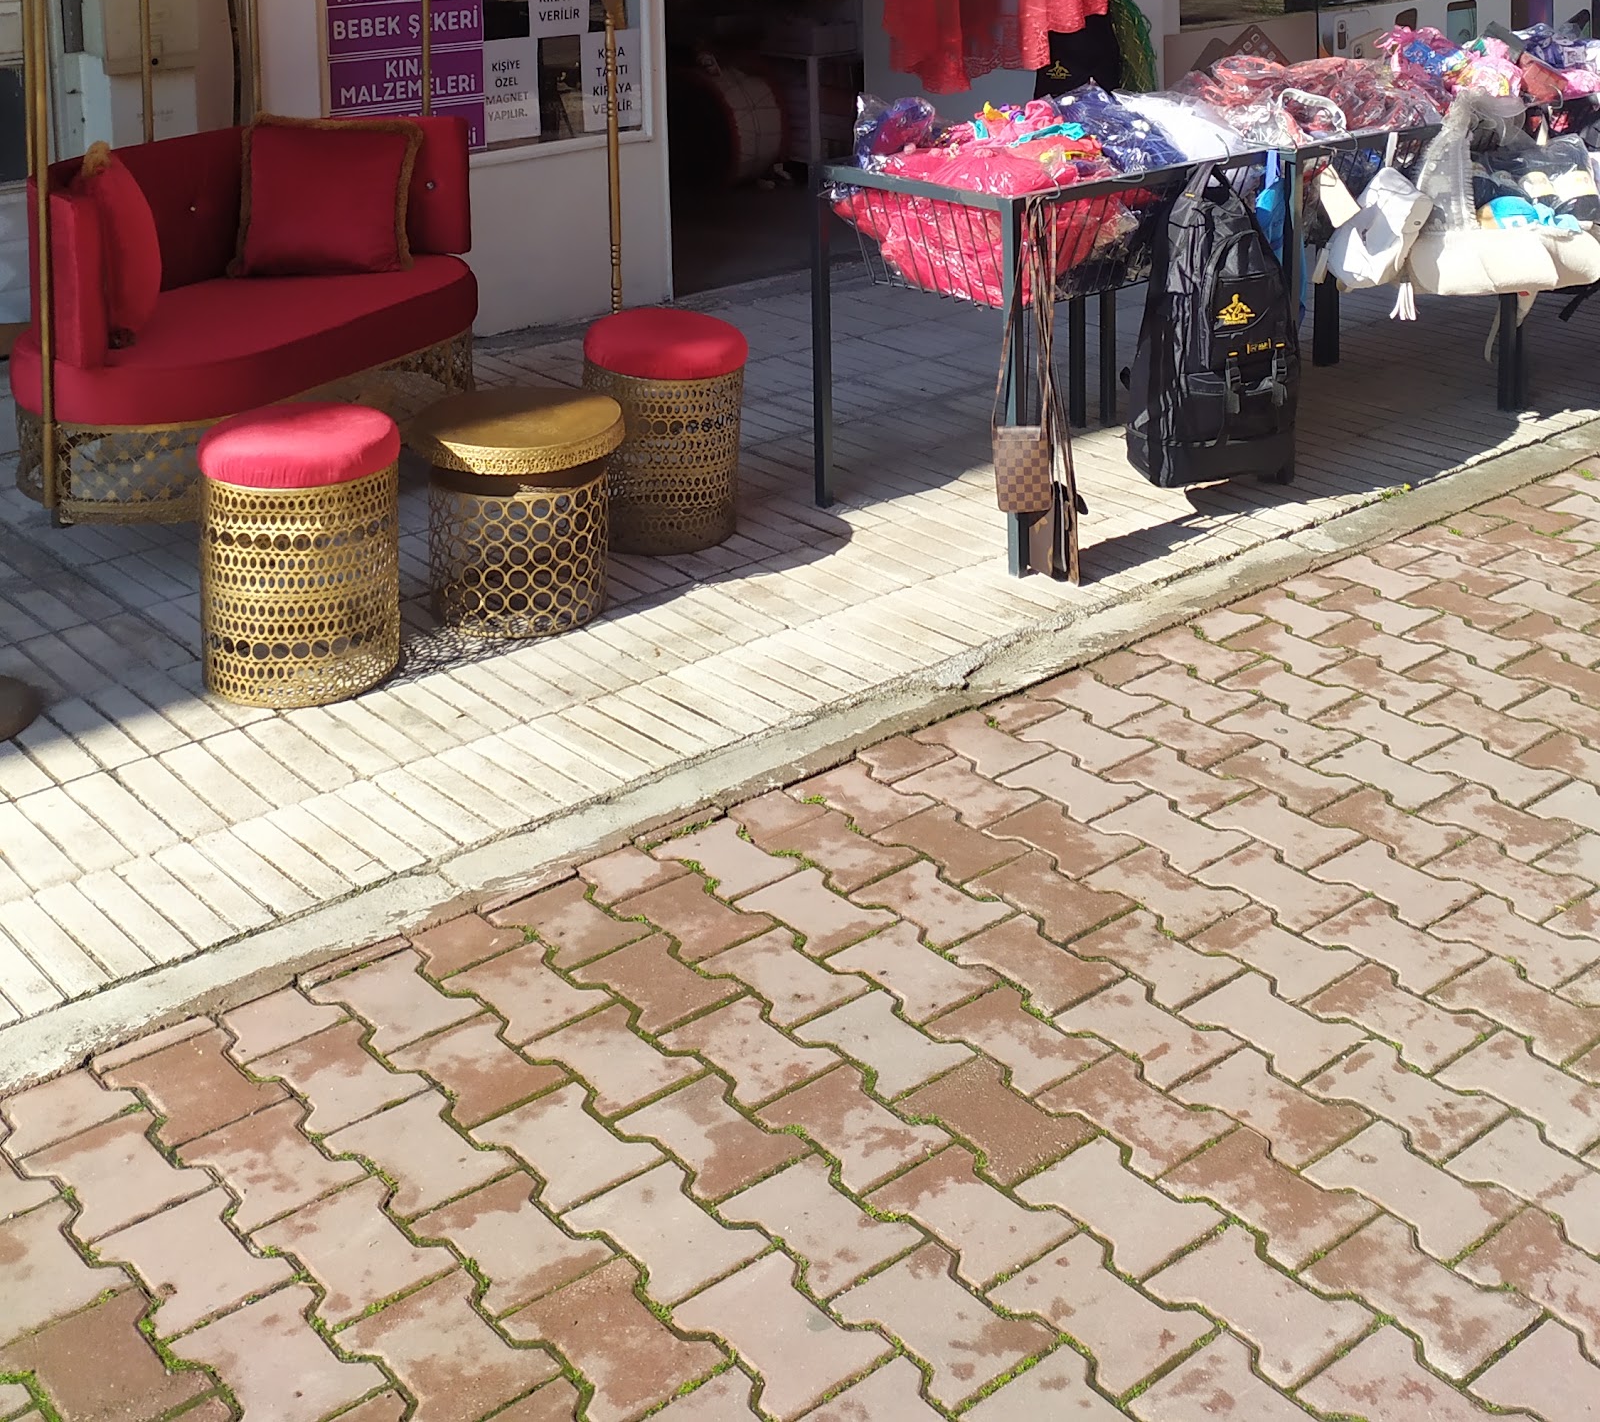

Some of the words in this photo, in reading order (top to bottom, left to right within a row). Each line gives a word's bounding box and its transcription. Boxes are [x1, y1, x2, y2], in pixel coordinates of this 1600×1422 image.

[539, 8, 580, 21] VERİLİR
[333, 15, 400, 40] BEBEK
[408, 5, 478, 38] ŞKERİ
[598, 47, 625, 59] KA
[386, 58, 432, 79] KIN
[485, 91, 528, 106] MAGNET
